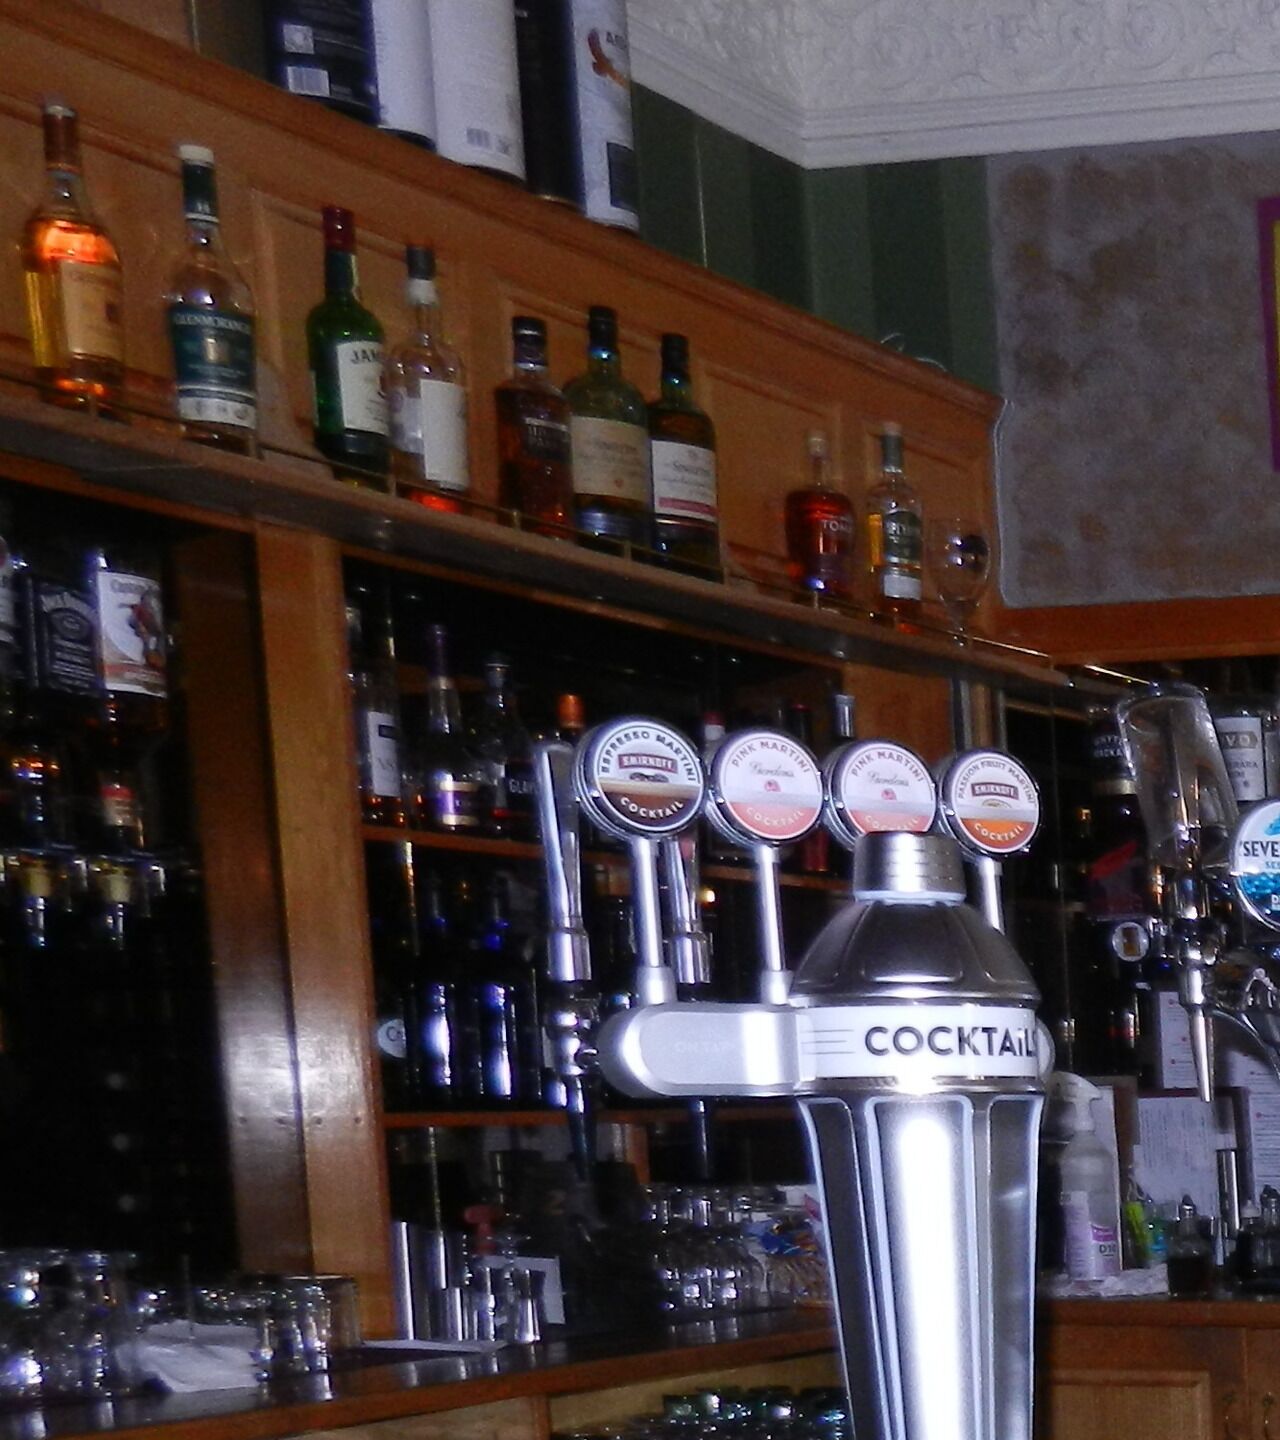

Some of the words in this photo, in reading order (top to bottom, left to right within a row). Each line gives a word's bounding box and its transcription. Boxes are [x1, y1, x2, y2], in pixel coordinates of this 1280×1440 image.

[621, 756, 674, 771] SMIRNOFF
[655, 733, 697, 782] MARTINI
[733, 744, 755, 768] PINK
[760, 741, 811, 774] MARTINI
[851, 753, 874, 777] PINK
[877, 751, 925, 783] MARTINI
[1008, 765, 1036, 804] MARTINI
[620, 796, 685, 819] COCKTAIL
[745, 805, 805, 827] COCKTAIL
[974, 823, 1026, 842] COCKTAIL
